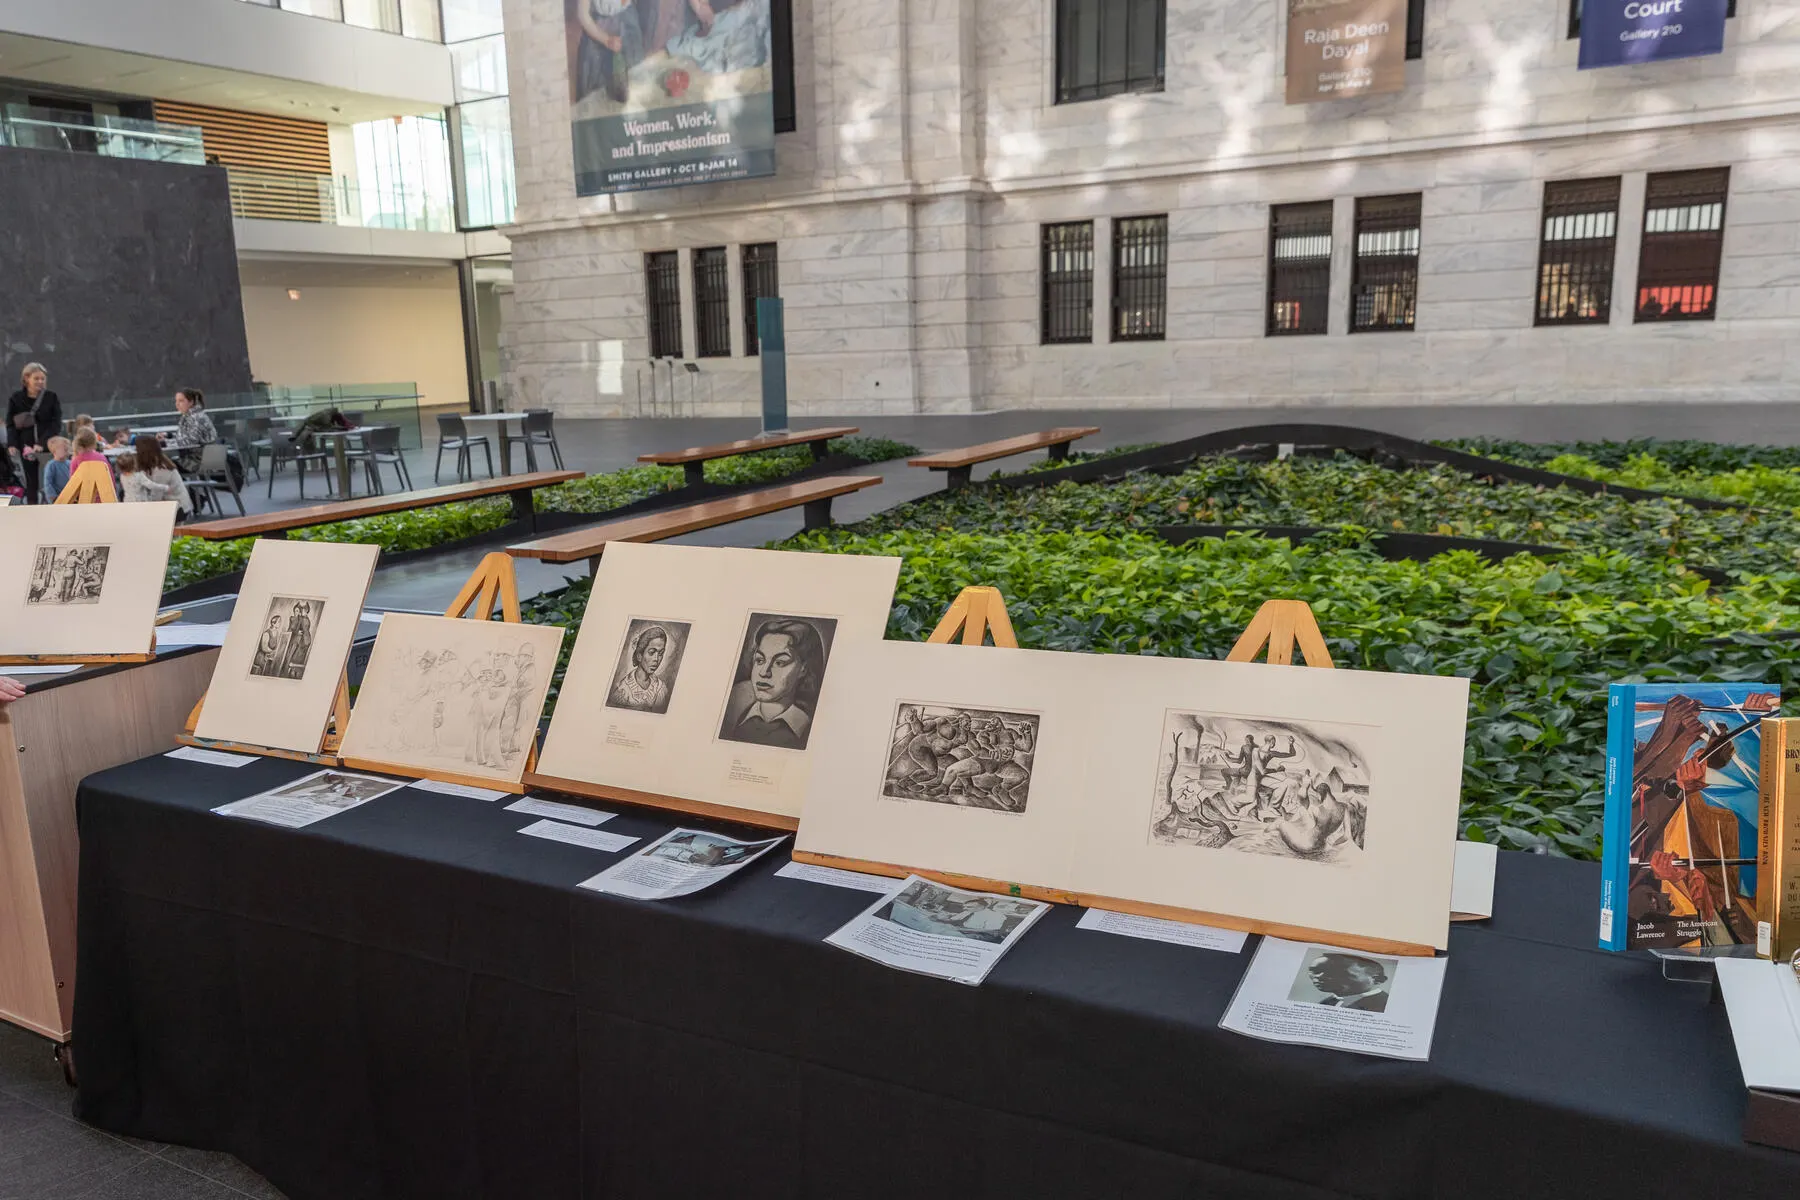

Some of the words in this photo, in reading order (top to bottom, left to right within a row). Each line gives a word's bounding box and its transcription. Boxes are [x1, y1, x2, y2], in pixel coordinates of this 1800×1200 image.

[1623, 0, 1683, 19] Court
[1304, 28, 1340, 44] Raja
[1345, 21, 1390, 39] Deen
[1619, 27, 1660, 42] Gallery
[1322, 39, 1369, 60] Dayal
[623, 119, 674, 137] Women,
[676, 111, 717, 130] Work,
[611, 142, 634, 159] and
[637, 131, 731, 157] Impressionism
[607, 171, 633, 182] SMITH
[634, 166, 672, 179] GALLERY
[679, 162, 697, 174] OCT
[1636, 922, 1655, 931] Jacob
[1676, 920, 1689, 928] The
[1690, 919, 1718, 928] American
[1676, 928, 1702, 938] Struggle
[1636, 931, 1665, 939] Lawrence
